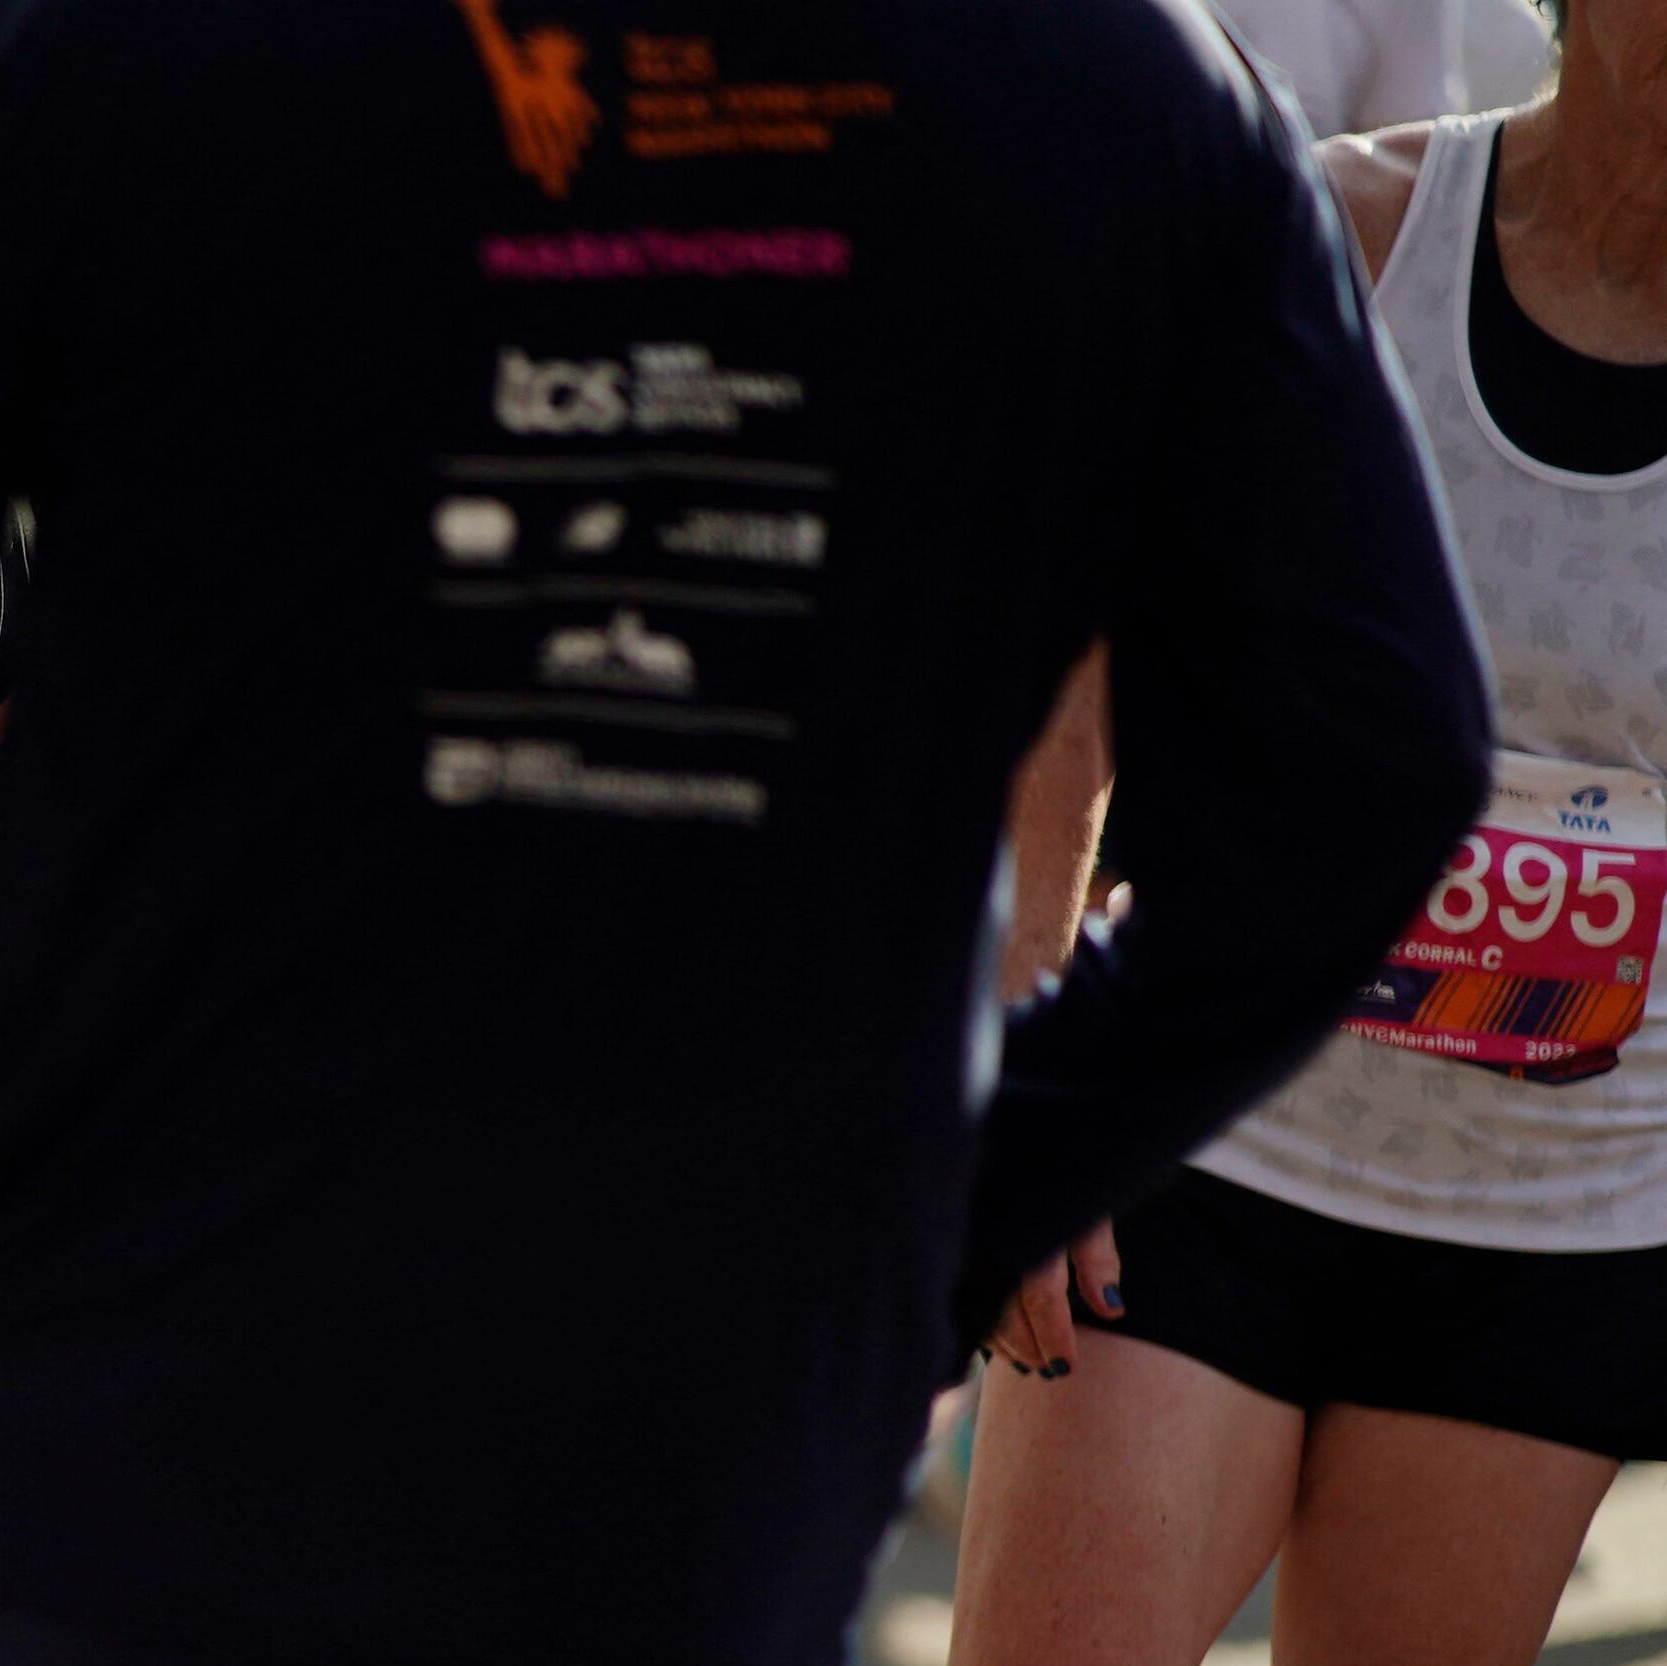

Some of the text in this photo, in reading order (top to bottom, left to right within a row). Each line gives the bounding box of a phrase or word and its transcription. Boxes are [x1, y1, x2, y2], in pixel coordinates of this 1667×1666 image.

[1558, 810, 1611, 833] TATA
[1404, 940, 1477, 968] CORRAL
[1480, 943, 1504, 972] C
